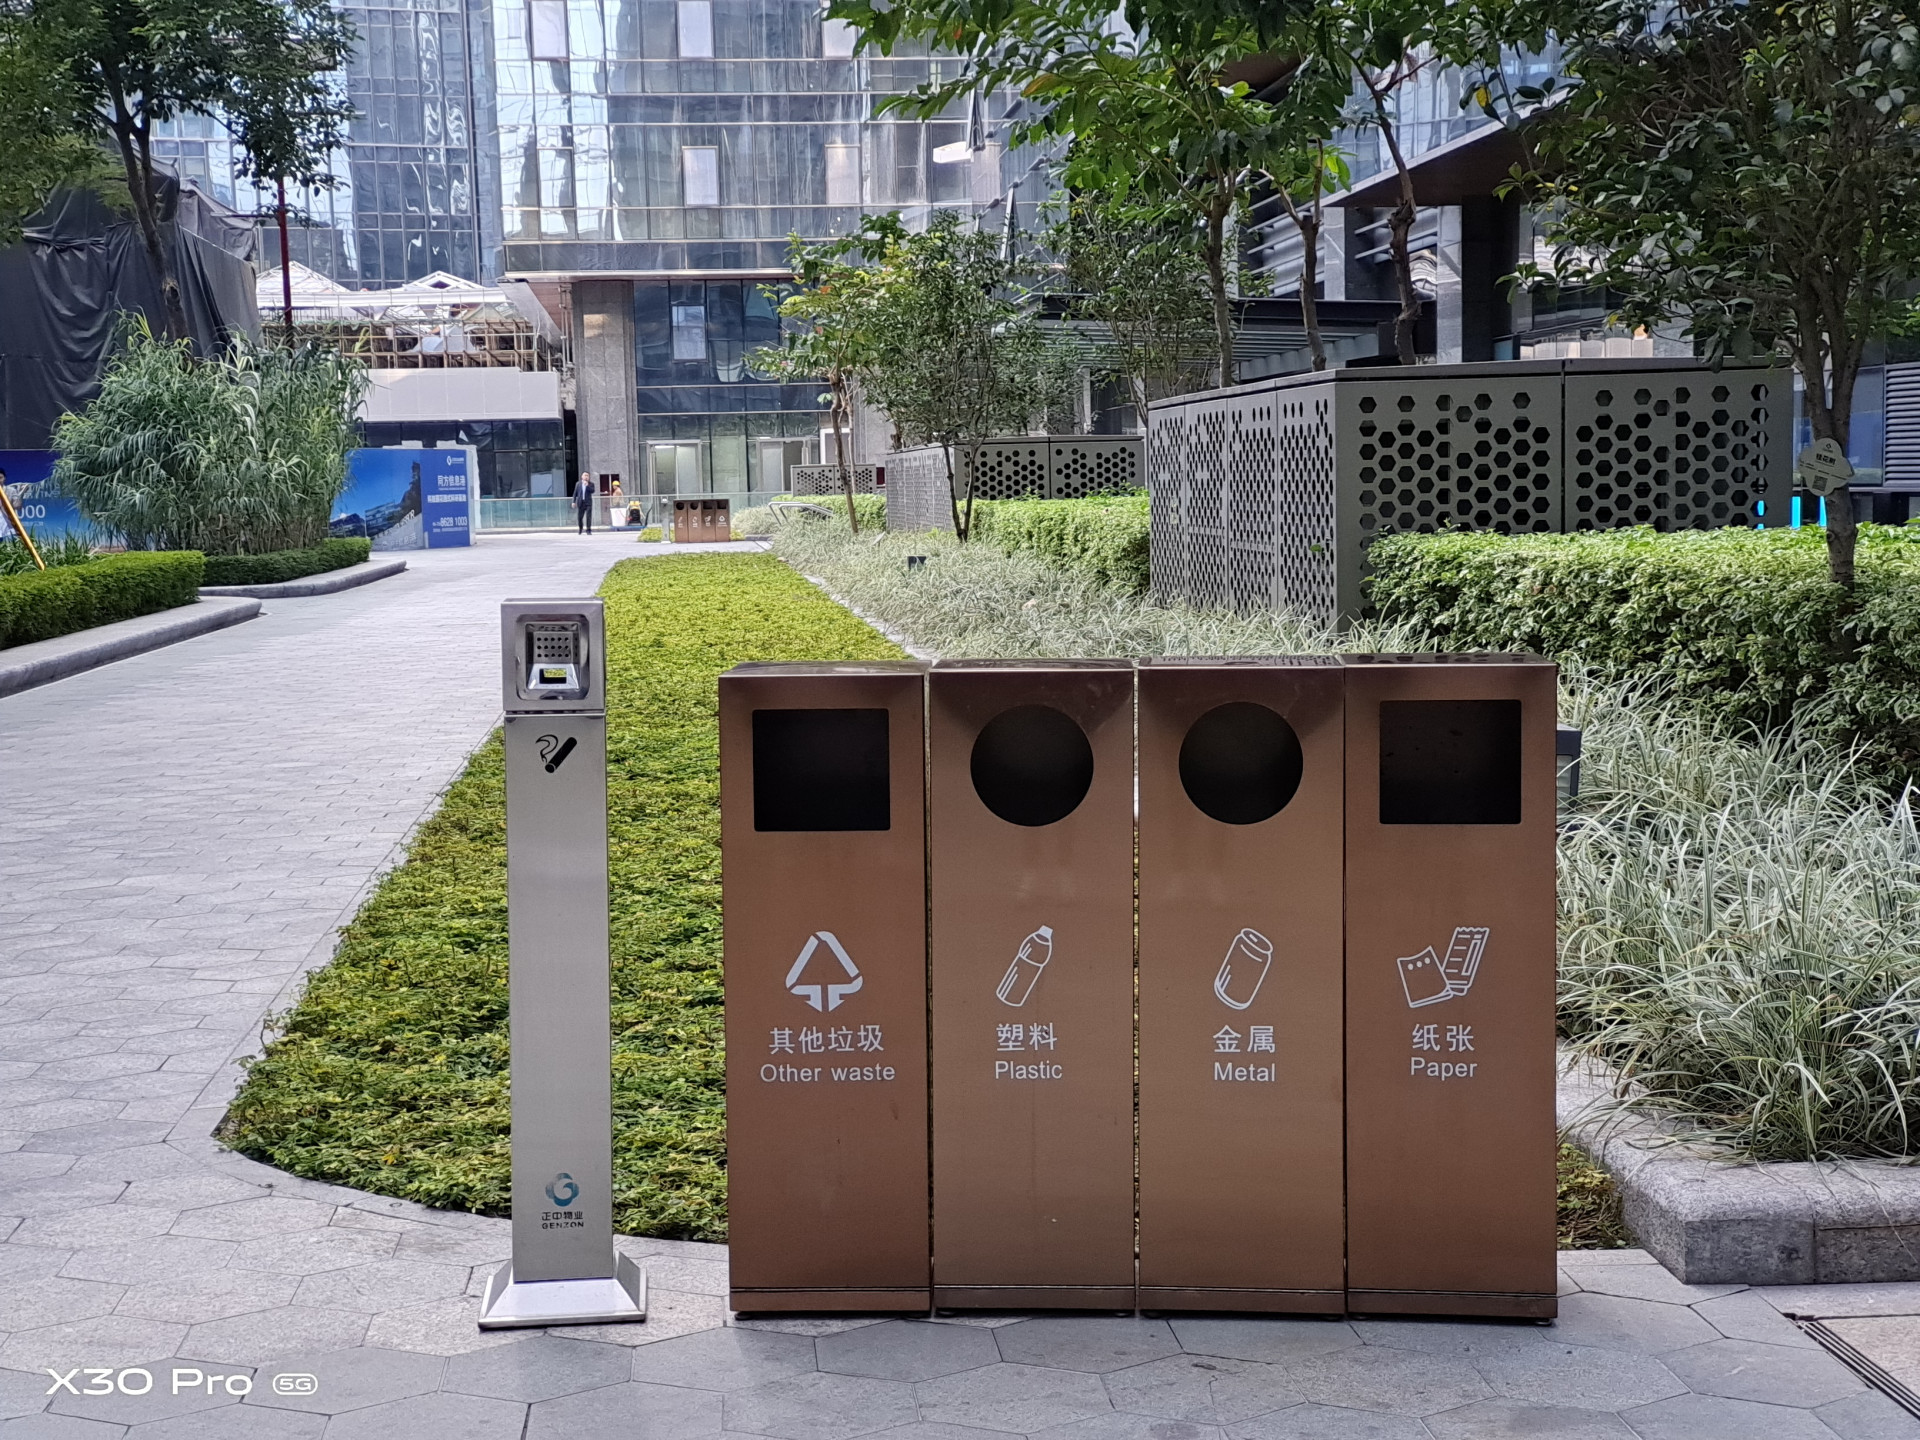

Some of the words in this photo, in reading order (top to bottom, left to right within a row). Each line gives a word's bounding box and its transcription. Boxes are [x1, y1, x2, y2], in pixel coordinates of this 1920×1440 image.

[769, 1024, 884, 1055] 其他垃圾
[996, 1022, 1057, 1051] 塑料
[1213, 1024, 1276, 1053] 金属
[1412, 1023, 1475, 1052] 纸张
[760, 1063, 822, 1082] Other
[831, 1063, 896, 1081] waste
[995, 1060, 1063, 1079] Plastic
[1214, 1061, 1275, 1082] Metal
[1410, 1057, 1478, 1081] Paper
[541, 1211, 583, 1221] 正中物业
[541, 1221, 584, 1230] GENZON
